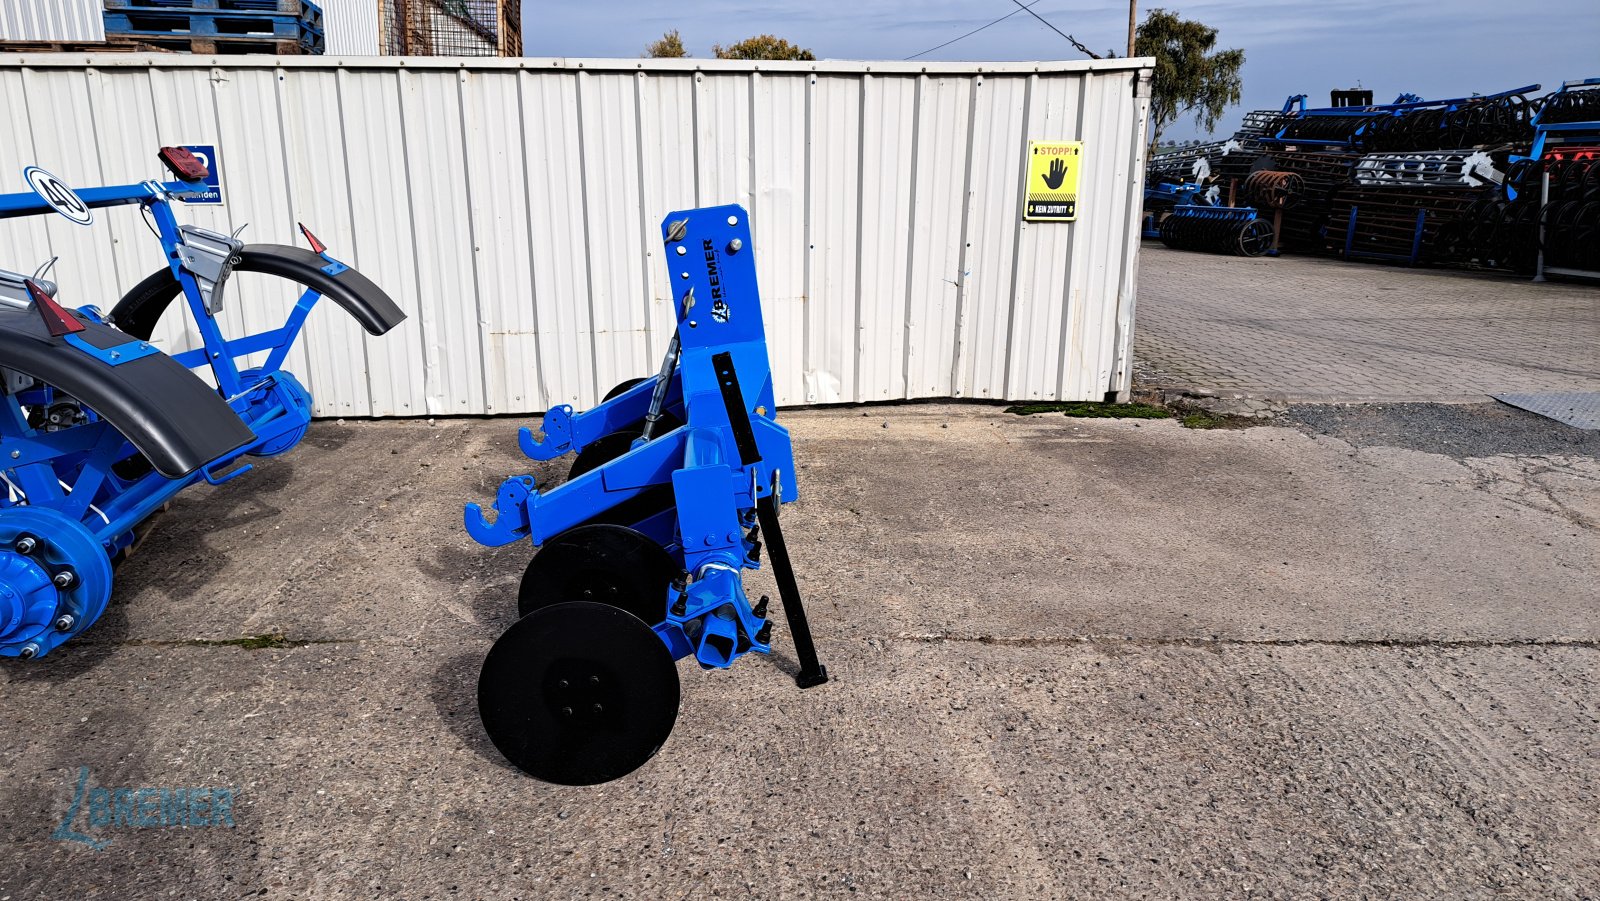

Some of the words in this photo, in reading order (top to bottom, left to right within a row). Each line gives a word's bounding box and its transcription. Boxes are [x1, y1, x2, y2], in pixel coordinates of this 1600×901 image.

[1040, 147, 1073, 156] STOPP!
[38, 178, 86, 214] 40
[1035, 205, 1047, 214] KEIN
[1047, 205, 1068, 214] ZUTRITT
[702, 238, 724, 310] BREMER
